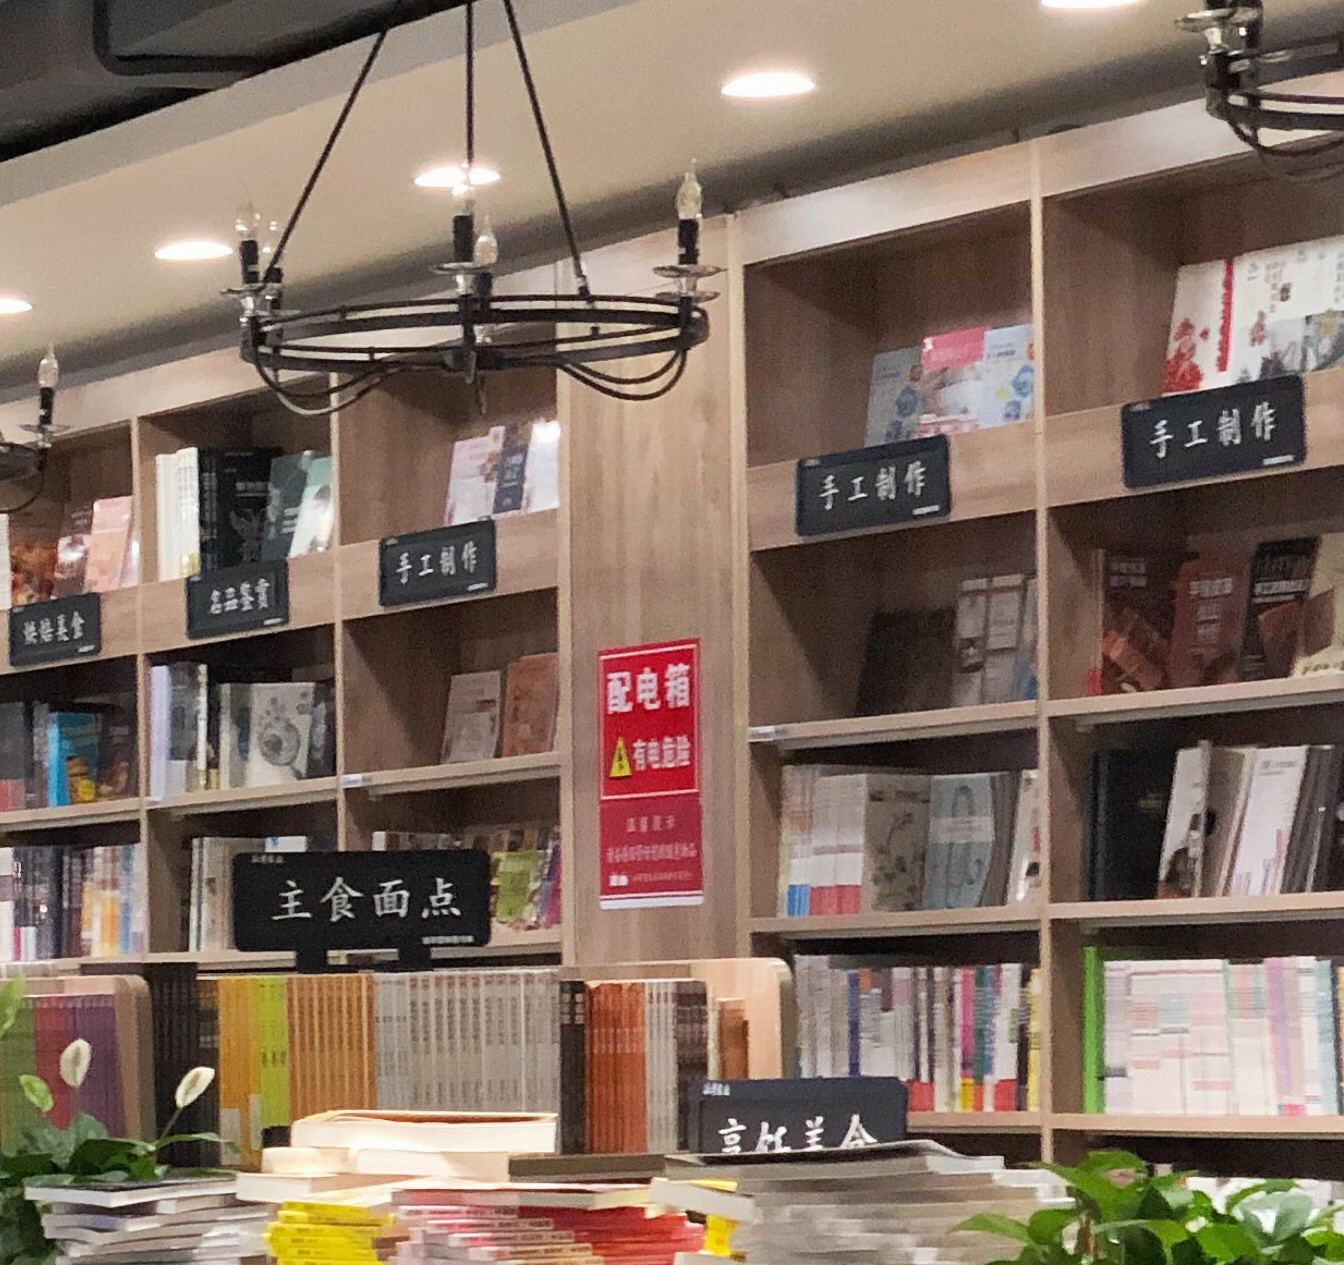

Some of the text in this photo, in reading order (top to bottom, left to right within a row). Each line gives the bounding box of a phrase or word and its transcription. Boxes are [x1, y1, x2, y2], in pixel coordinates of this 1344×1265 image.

[1150, 401, 1278, 459] 手工制作
[819, 461, 926, 510] 手工制作
[395, 545, 479, 584] 手工制作
[606, 663, 690, 714] 配电箱
[633, 735, 691, 770] 有电危险
[271, 876, 461, 922] 主食面点
